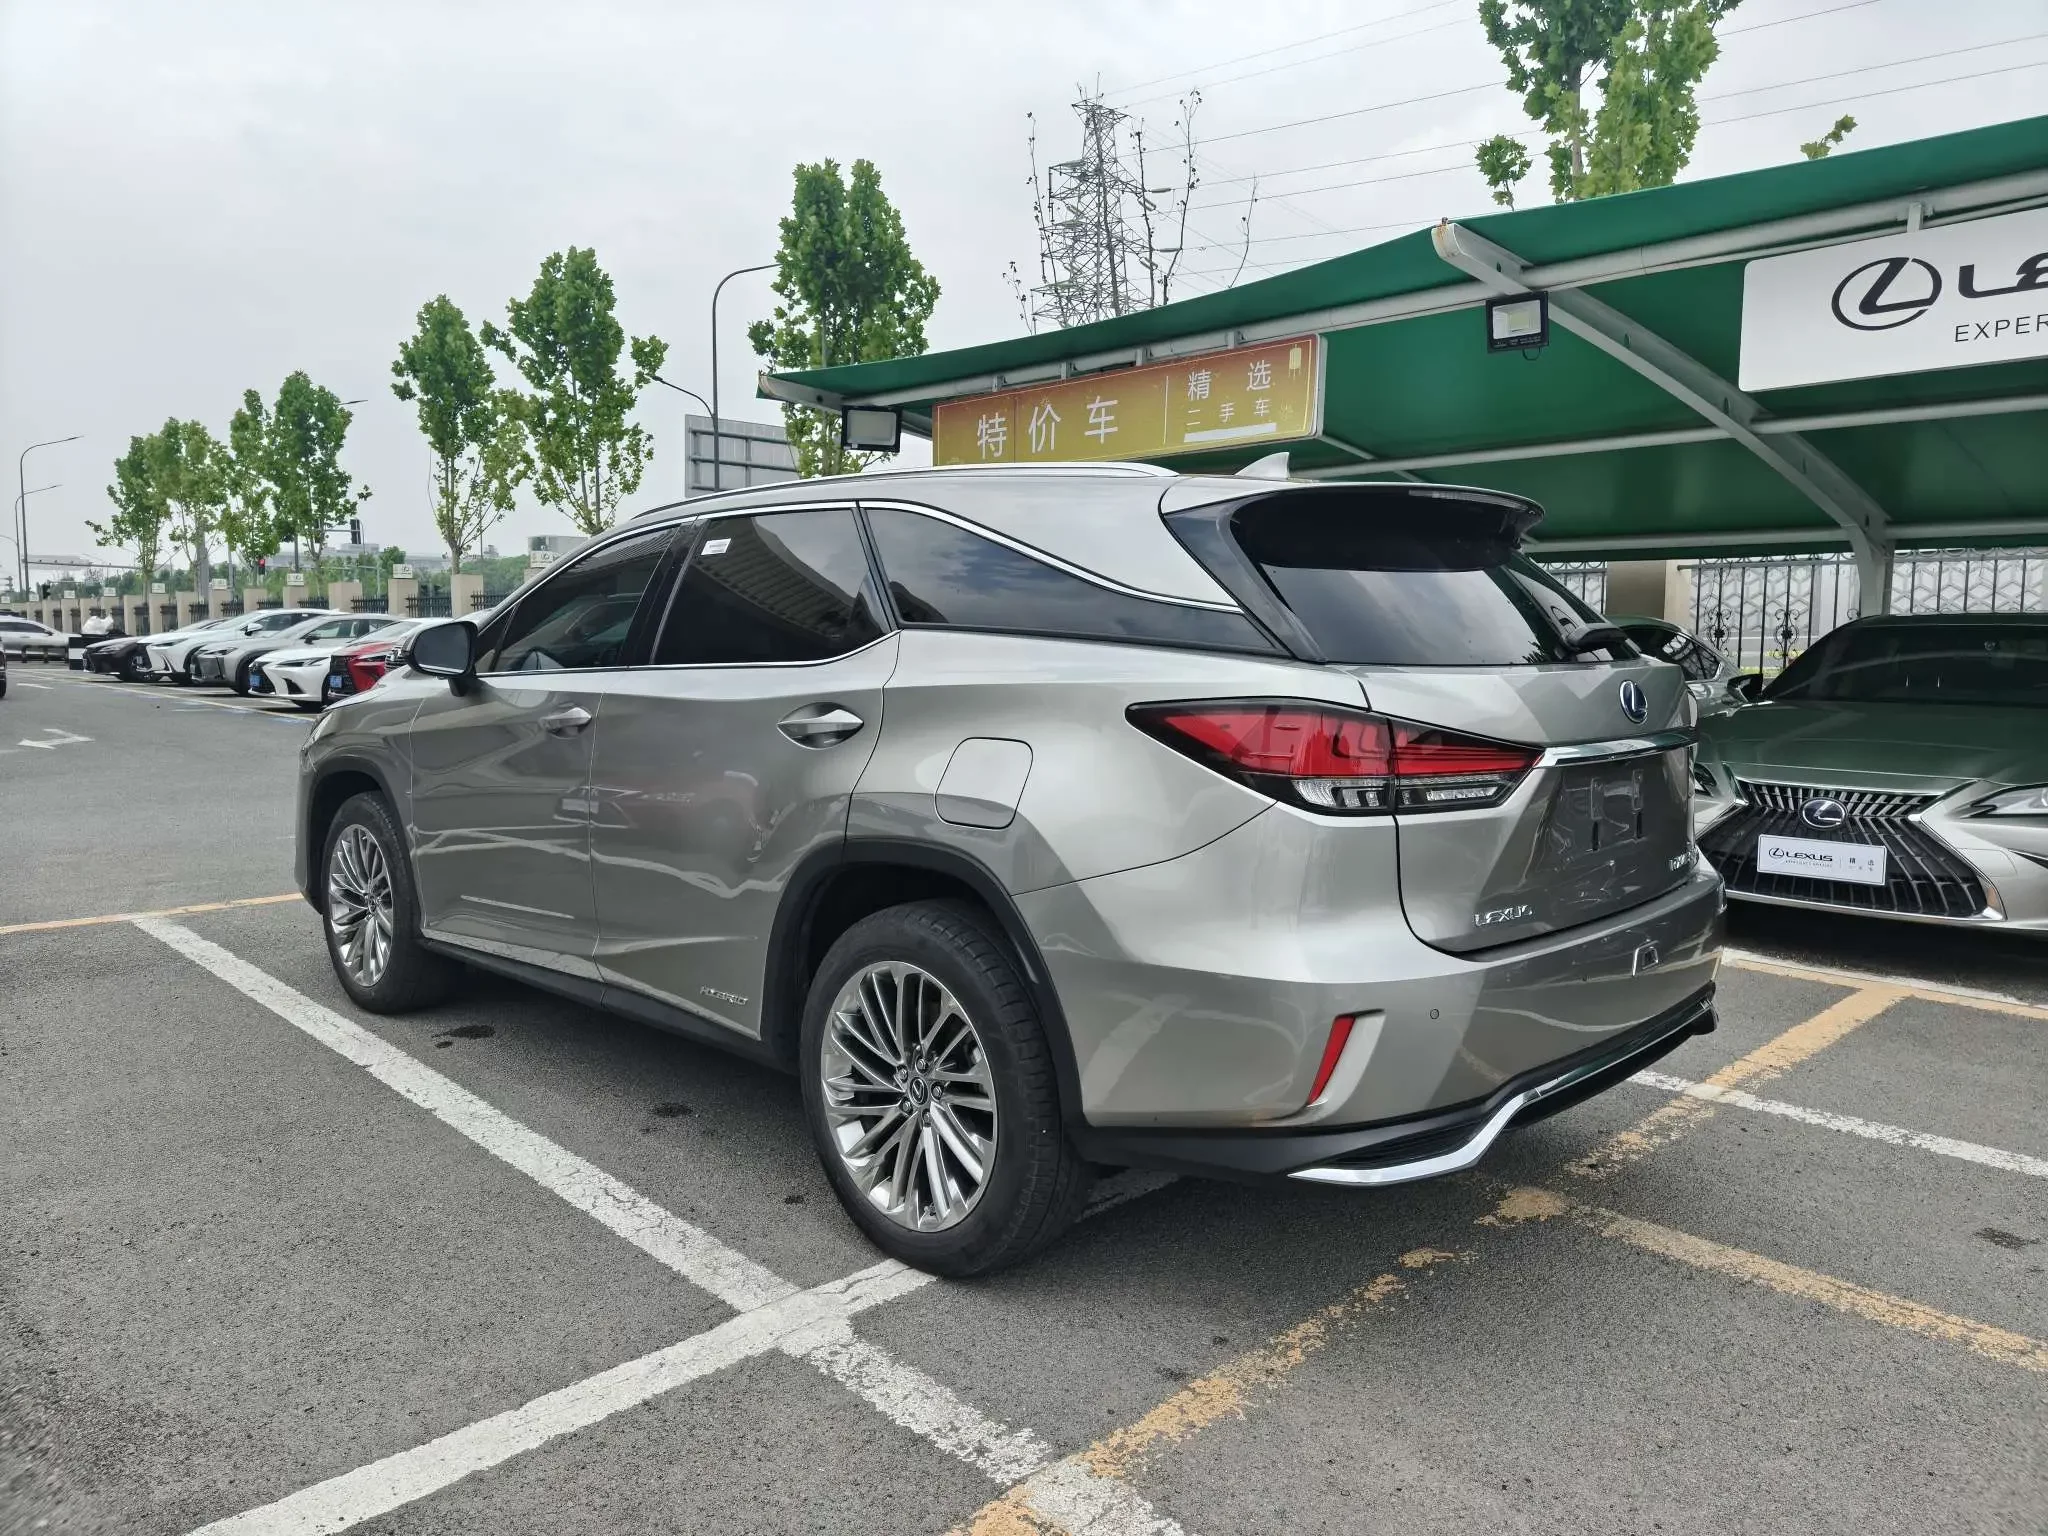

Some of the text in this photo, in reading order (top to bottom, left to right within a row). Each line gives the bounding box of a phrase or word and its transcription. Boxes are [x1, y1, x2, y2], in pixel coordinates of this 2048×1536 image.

[1187, 359, 1272, 401] 精选
[1186, 397, 1271, 426] 二手车
[976, 395, 1120, 459] 特价车
[1785, 851, 1833, 862] LEXUS
[1474, 904, 1533, 927] LEXUS
